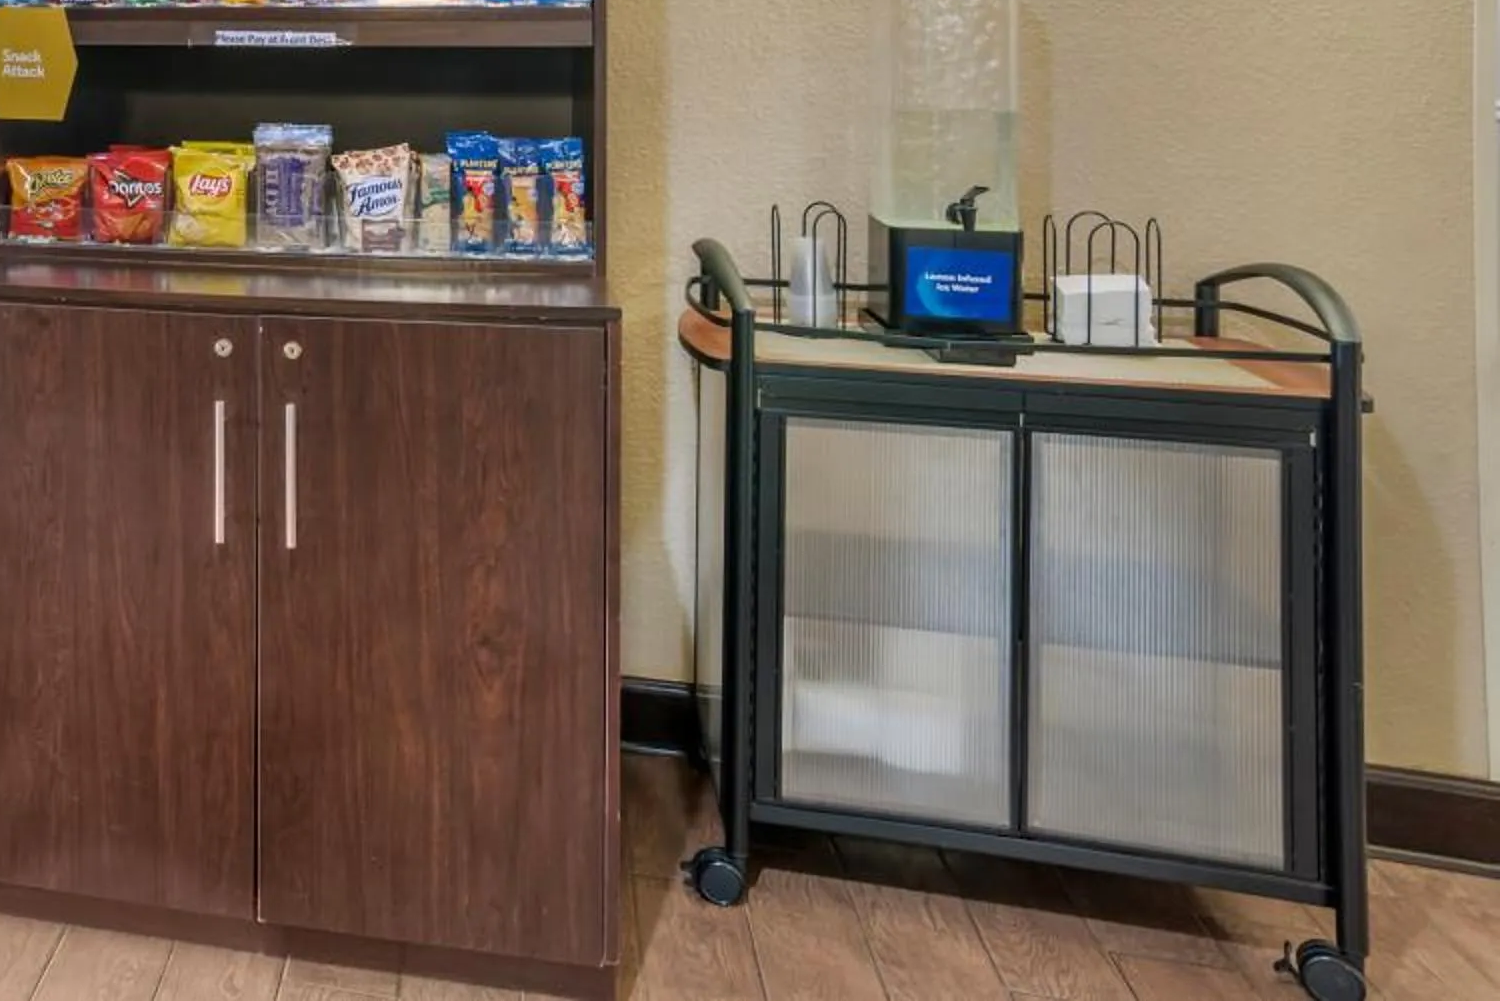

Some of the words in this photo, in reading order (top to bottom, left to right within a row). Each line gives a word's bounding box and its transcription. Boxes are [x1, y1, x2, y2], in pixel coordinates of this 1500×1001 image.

[2, 48, 41, 63] Snack
[2, 64, 45, 78] Attack
[109, 179, 162, 196] Doritos
[192, 174, 229, 196] Lay's
[347, 178, 403, 205] Famous
[354, 193, 398, 217] Amos
[923, 271, 956, 282] Lemon
[957, 273, 993, 284] Infused
[935, 282, 951, 293] Ice
[951, 284, 980, 294] Water
